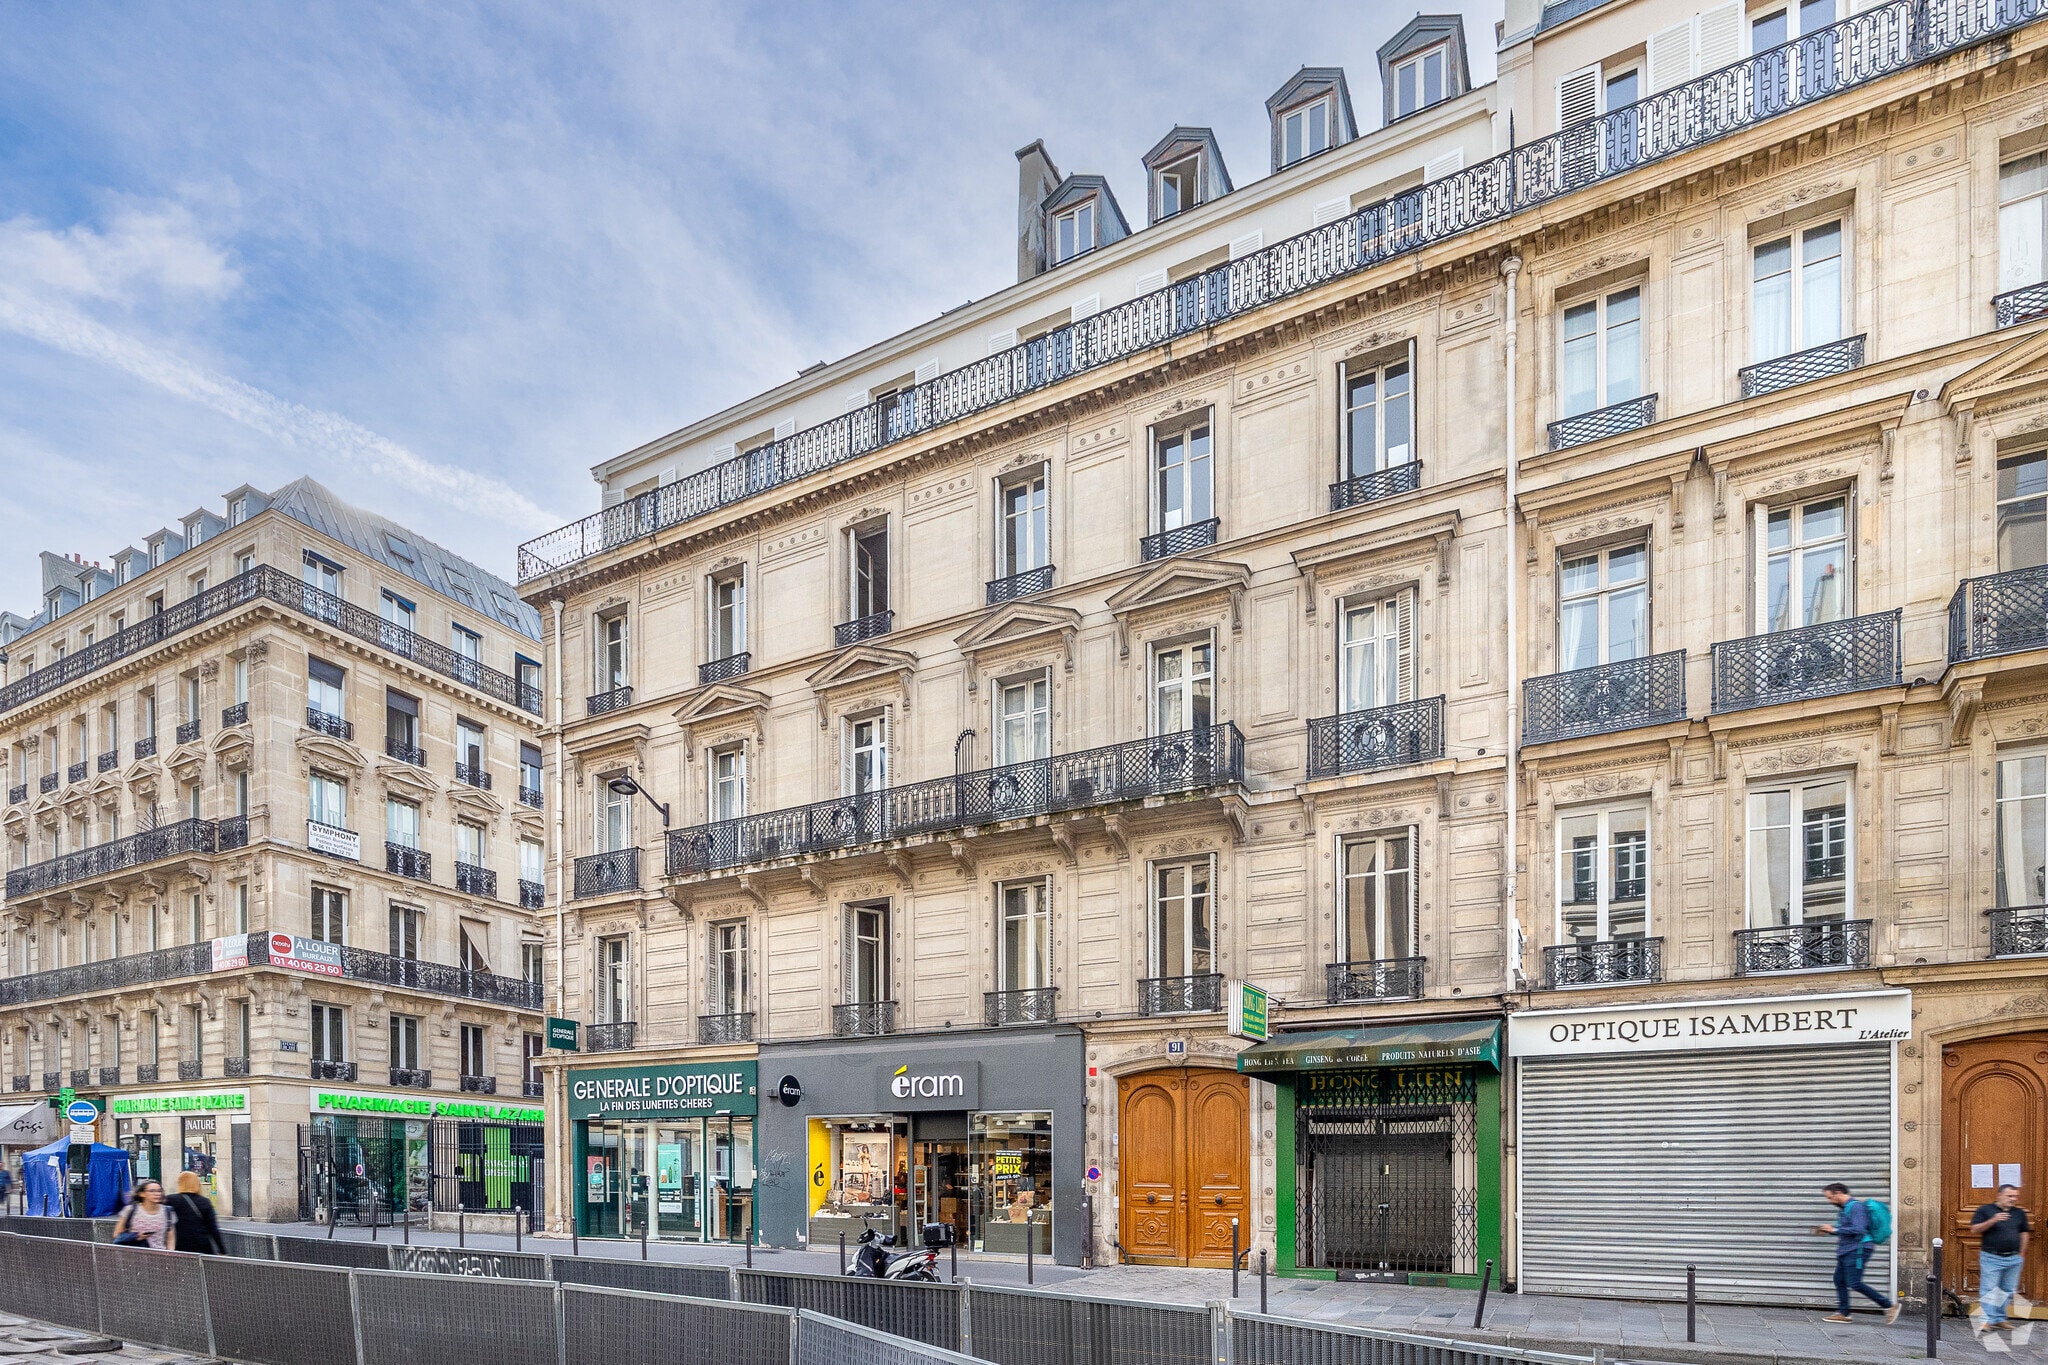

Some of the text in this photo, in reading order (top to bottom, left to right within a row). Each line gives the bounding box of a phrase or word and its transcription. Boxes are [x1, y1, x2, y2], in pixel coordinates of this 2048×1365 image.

[312, 825, 357, 842] SYMPHONY
[296, 938, 338, 956] À LOUER
[302, 951, 334, 963] BUREAUX
[274, 957, 340, 975] 01 40 06 29 60
[1550, 1008, 1858, 1043] OPTIQUE ISAMBERT
[1859, 1028, 1910, 1040] L'Atelier
[1171, 1042, 1181, 1052] 91
[1244, 1058, 1262, 1067] HONG
[1305, 1055, 1334, 1064] GINSENG
[1381, 1051, 1415, 1061] PRODUITS
[1418, 1048, 1455, 1059] NATURELS
[1457, 1046, 1481, 1056] D'ASIE
[573, 1073, 743, 1100] GENERALE D'OPTIQUE
[782, 1083, 801, 1096] éram
[891, 1064, 964, 1099] éram
[113, 1094, 245, 1113] PHARMACIE SAINT-LAZARE
[318, 1093, 432, 1115] PHARMACIE
[600, 1097, 713, 1112] LA FIN DES LUNETTES CHERES
[13, 1119, 45, 1134] Gigi
[188, 1120, 216, 1131] NATURE
[996, 1156, 1022, 1164] PETITS
[813, 1162, 825, 1187] é
[996, 1164, 1022, 1175] PRIX
